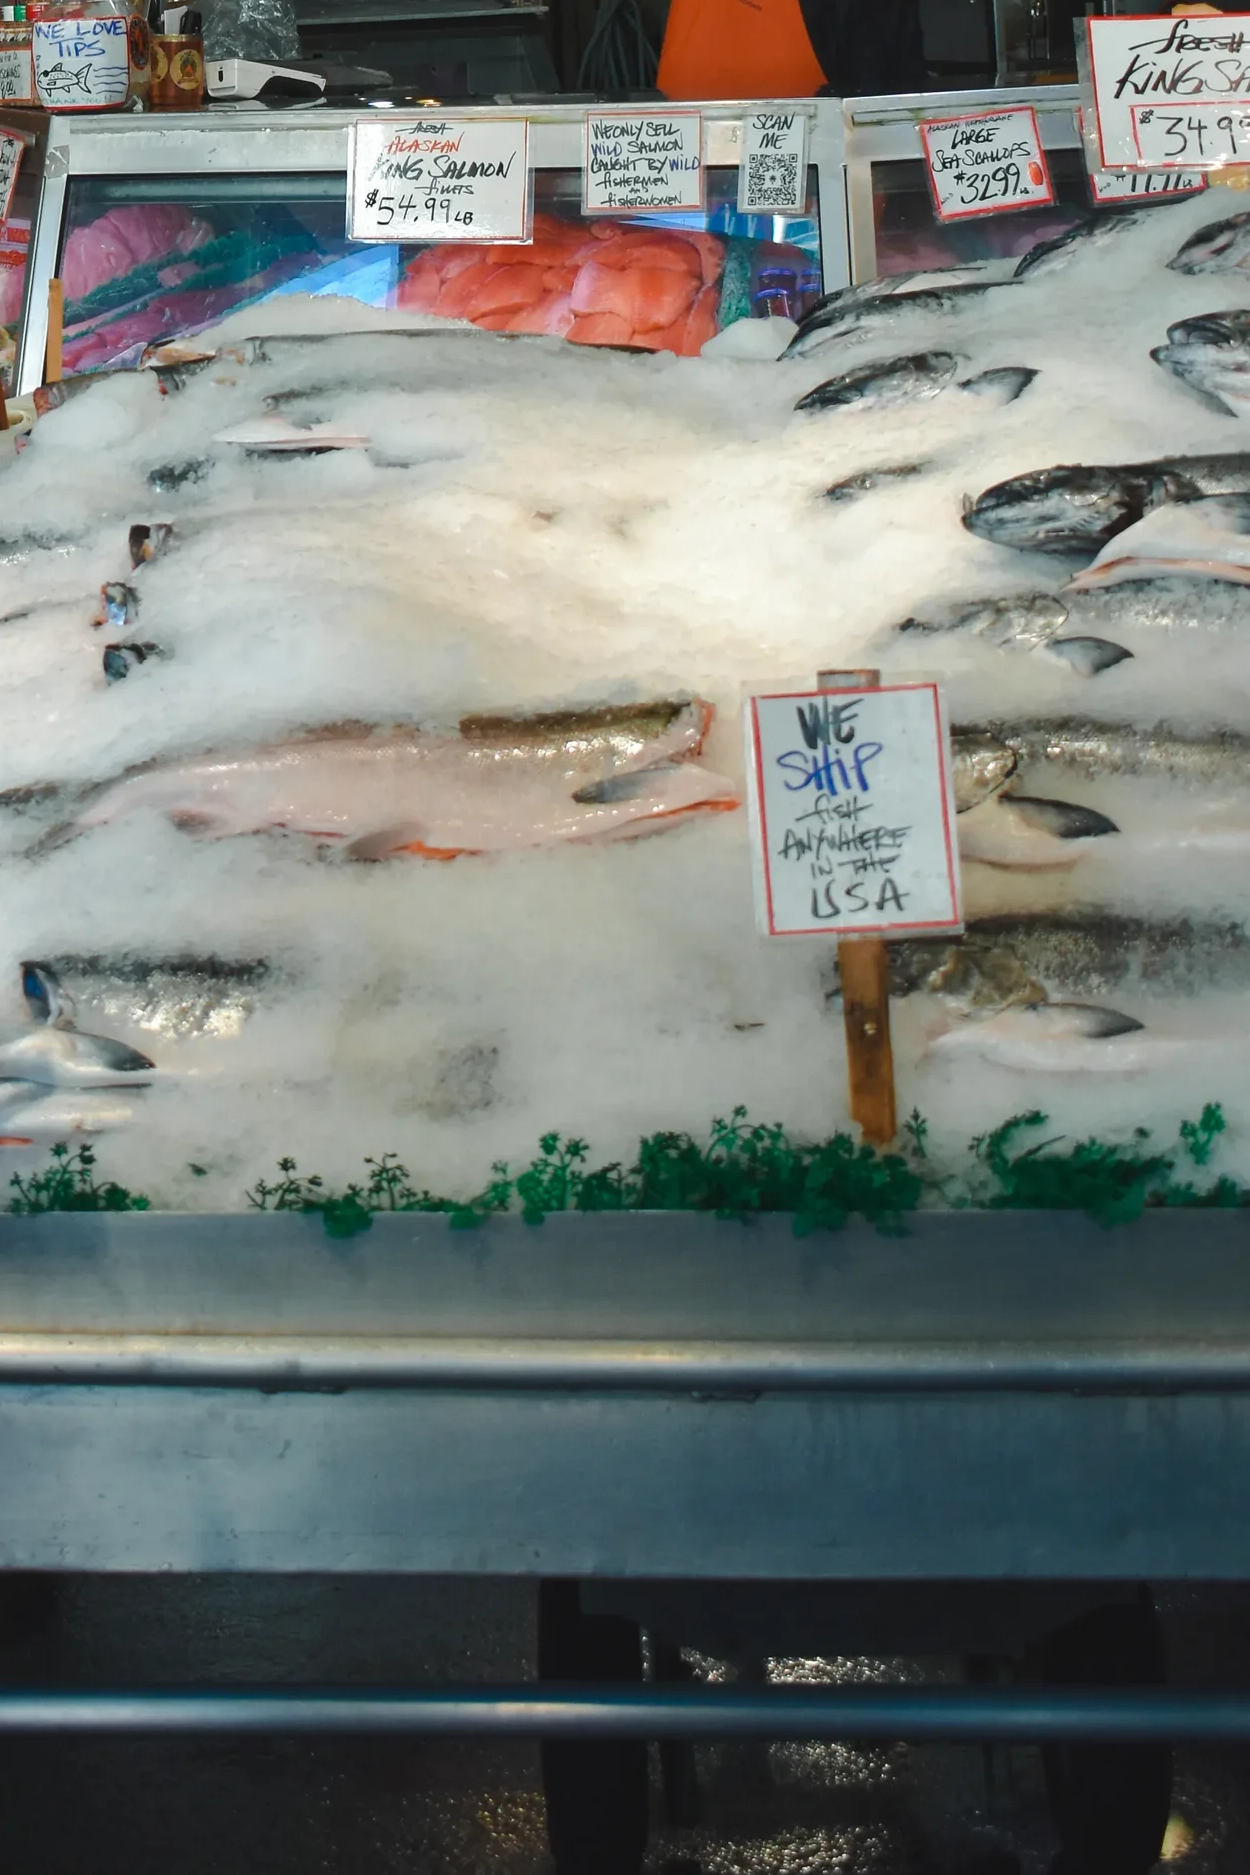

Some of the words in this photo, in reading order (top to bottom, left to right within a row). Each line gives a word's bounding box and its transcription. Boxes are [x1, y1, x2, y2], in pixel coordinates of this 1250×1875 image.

[35, 21, 65, 39] WE
[76, 20, 127, 36] LOVE
[49, 37, 106, 57] TIPS
[1114, 54, 1205, 99] KING
[614, 121, 644, 139] ONLY
[646, 122, 681, 137] SELL
[752, 112, 795, 131] SCAN
[387, 131, 465, 154] ALASKAN
[591, 140, 622, 157] WILD
[627, 132, 684, 153] SALMON
[758, 133, 789, 150] ME
[951, 128, 1000, 149] LARGE
[428, 151, 517, 179] SALMON
[590, 155, 645, 174] CAUGHT
[647, 156, 668, 174] BY
[668, 154, 700, 172] WILD
[932, 149, 961, 172] SEA
[962, 141, 1031, 166] SCALLOPS
[454, 211, 473, 225] LB
[797, 696, 864, 749] WE
[776, 742, 882, 796] SHIP
[794, 793, 874, 823] FISH
[778, 825, 912, 861] ANYWHERE
[811, 861, 833, 880] IN
